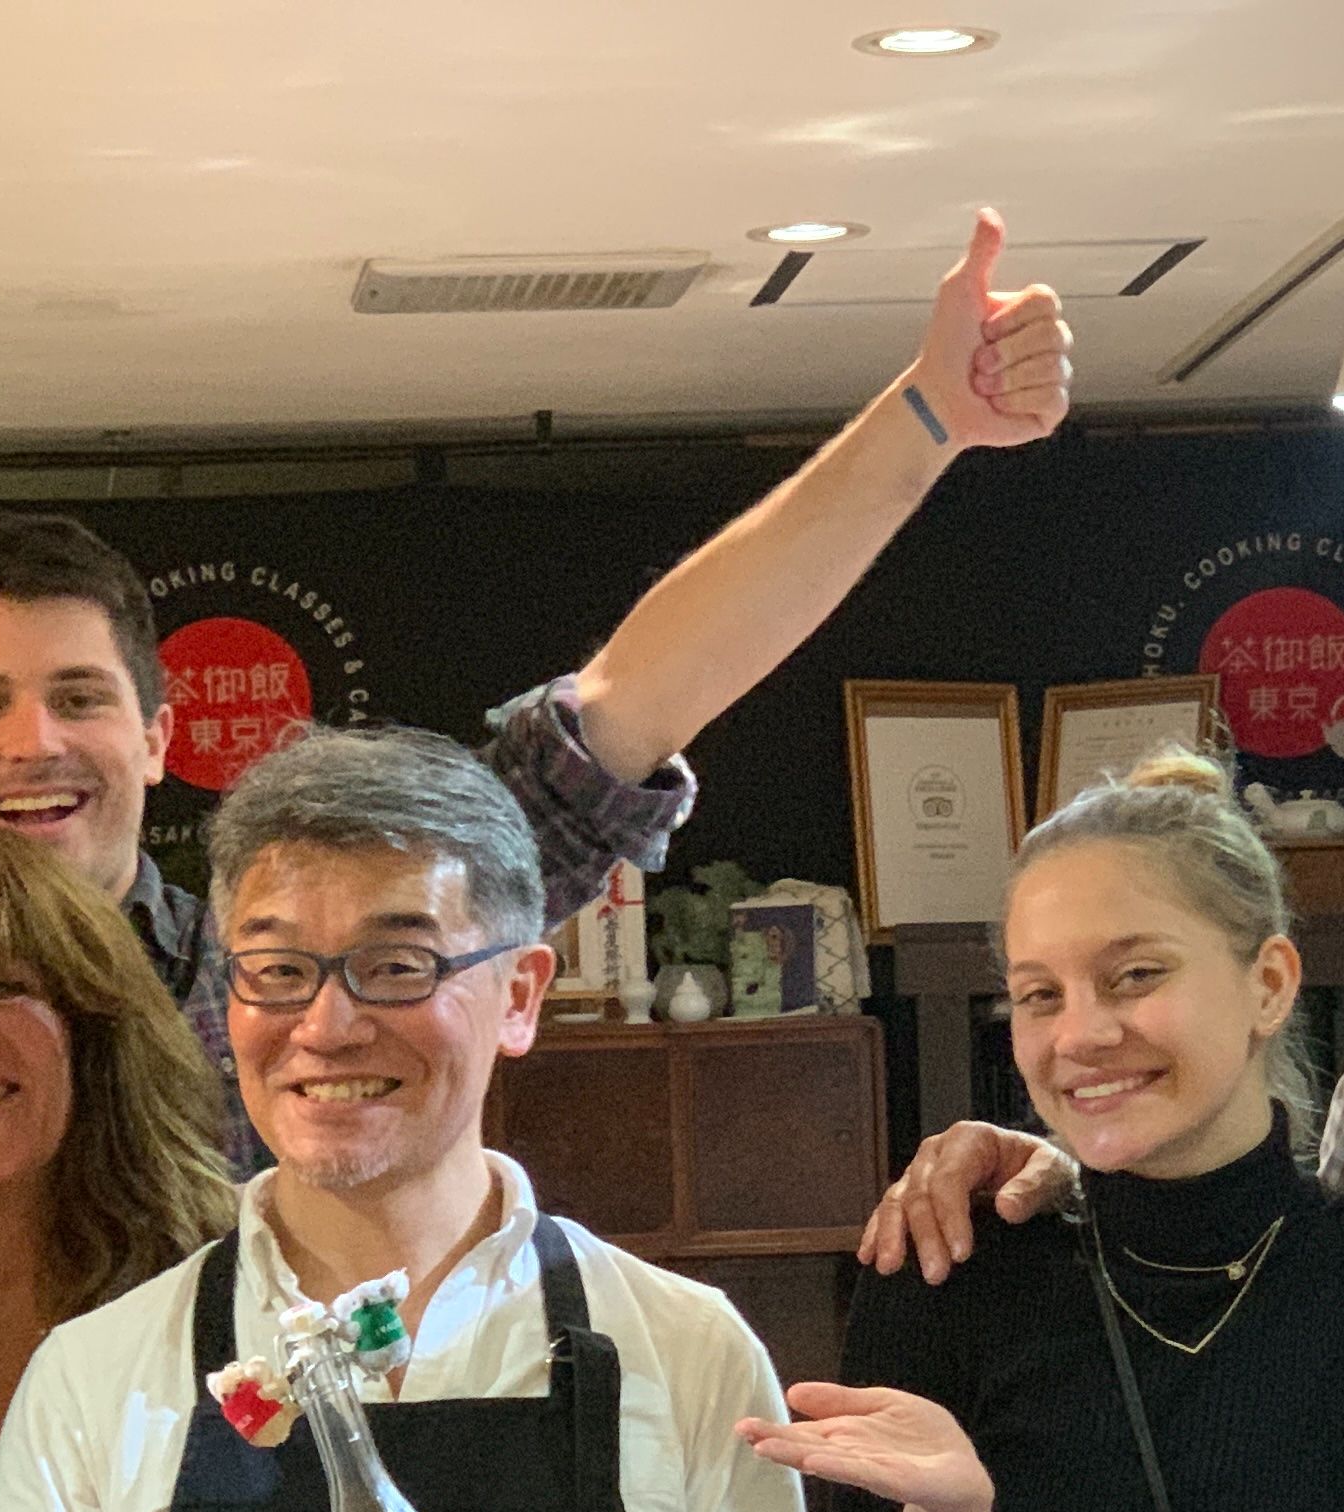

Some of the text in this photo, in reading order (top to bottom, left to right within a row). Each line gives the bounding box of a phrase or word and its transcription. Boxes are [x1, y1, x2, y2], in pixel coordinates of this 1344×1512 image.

[1184, 533, 1302, 590] COOKING
[150, 561, 236, 598] OKING
[251, 566, 353, 648] CLASSES
[349, 688, 369, 722] CA
[1247, 686, 1320, 722] 東京
[189, 718, 265, 753] 東京
